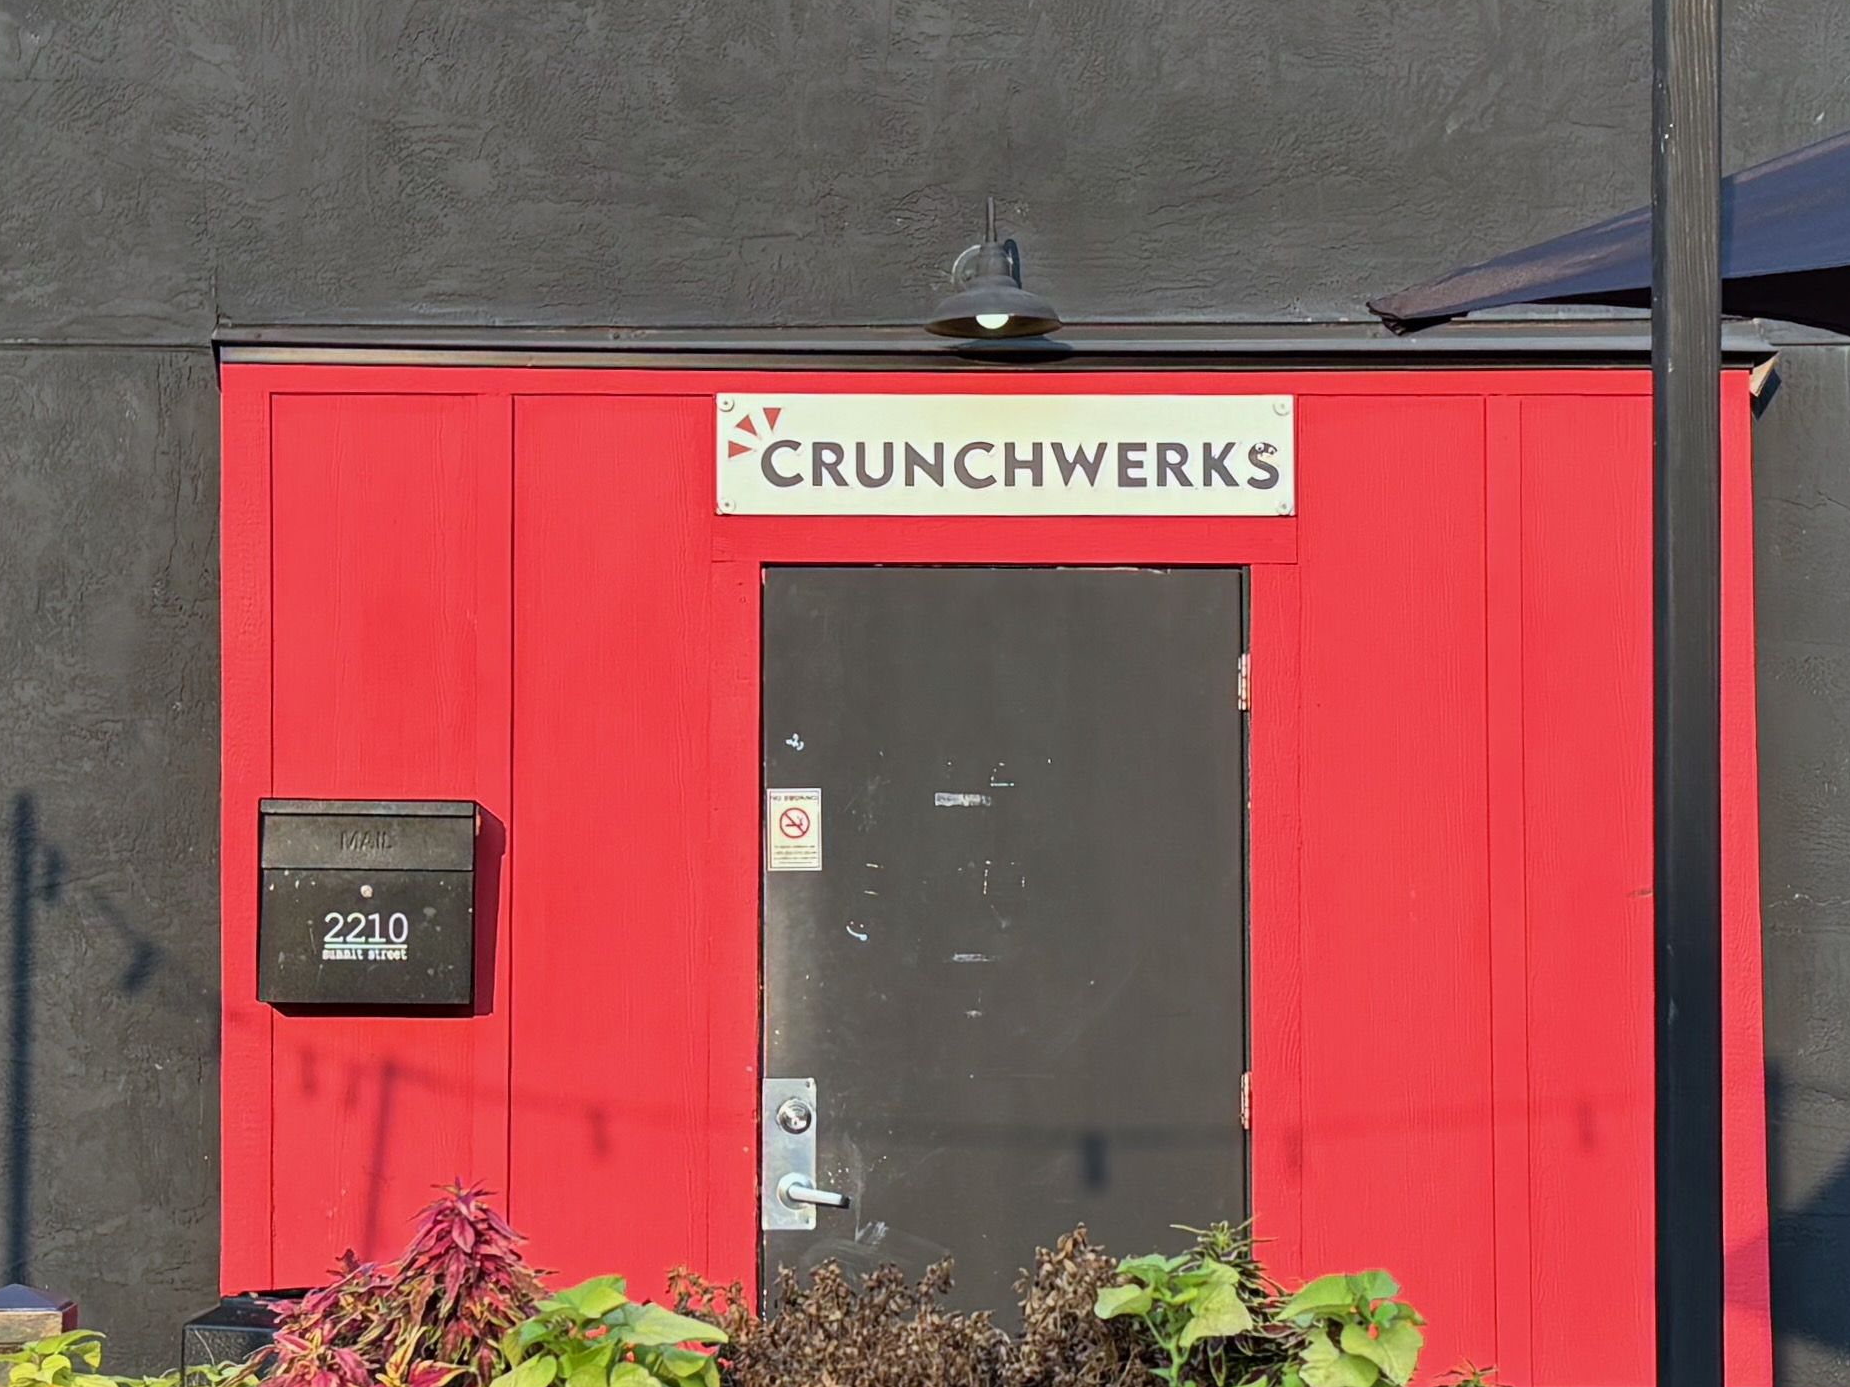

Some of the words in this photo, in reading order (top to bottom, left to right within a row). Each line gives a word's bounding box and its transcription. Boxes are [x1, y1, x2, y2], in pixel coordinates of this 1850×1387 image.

[760, 439, 1281, 491] CRUNCHWERKS
[340, 830, 392, 852] MAIL
[324, 912, 409, 943] 2210
